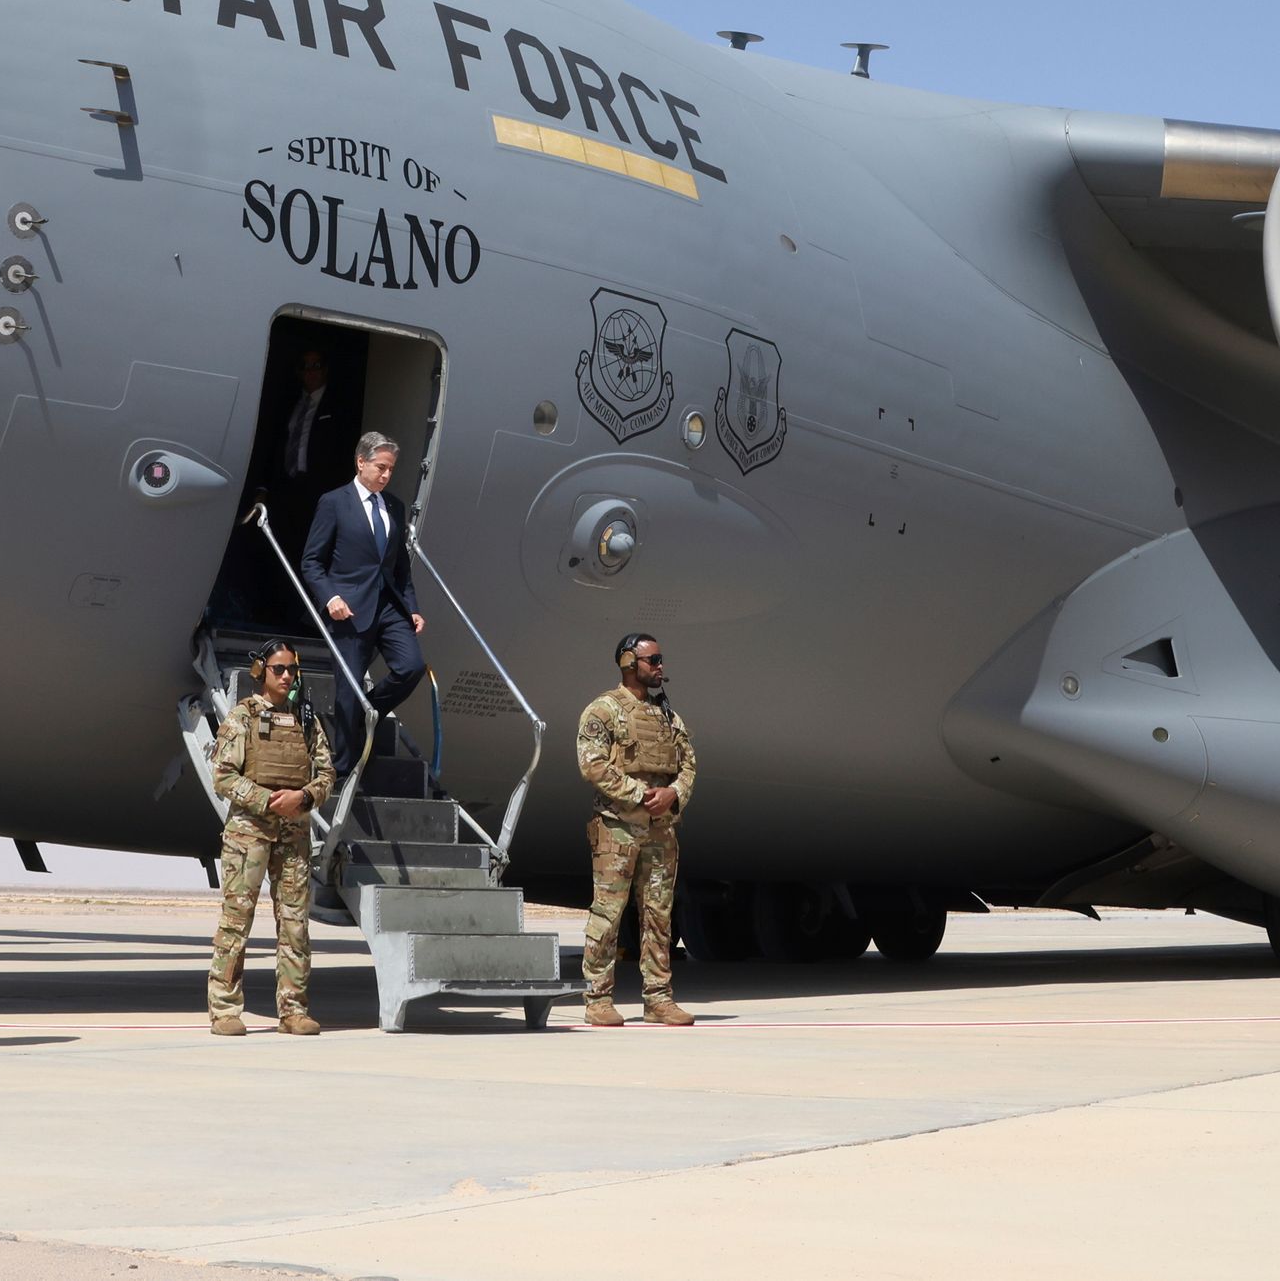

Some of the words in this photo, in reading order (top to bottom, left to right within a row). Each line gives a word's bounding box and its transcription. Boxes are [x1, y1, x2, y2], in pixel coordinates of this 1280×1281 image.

[432, 1, 729, 186] FORCE
[287, 136, 391, 182] SPIRIT
[402, 157, 441, 194] OF
[242, 179, 482, 290] SOLANO
[582, 381, 596, 403] AIR
[593, 400, 627, 437] MOBILITY
[630, 397, 667, 431] COMMAND
